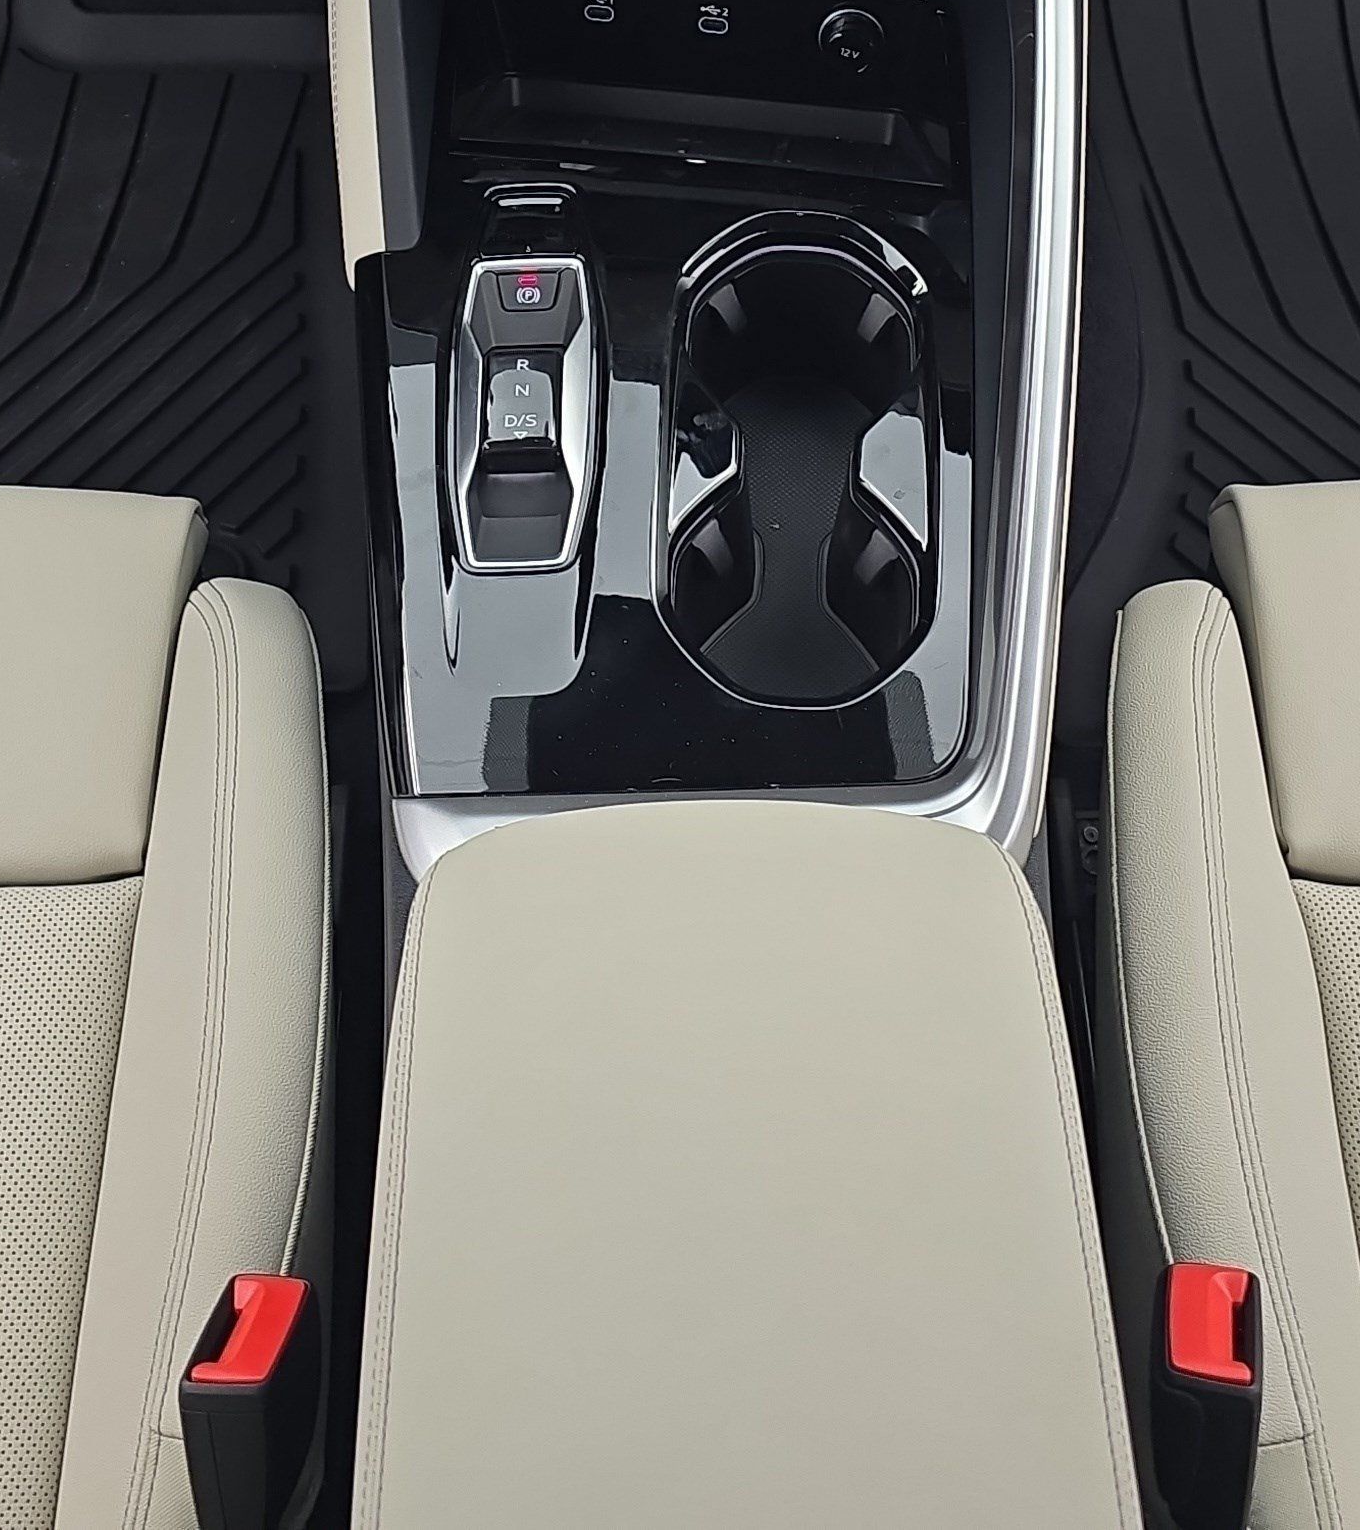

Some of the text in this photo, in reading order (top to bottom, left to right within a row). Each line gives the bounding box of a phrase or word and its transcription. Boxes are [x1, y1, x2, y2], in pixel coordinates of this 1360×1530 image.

[517, 358, 529, 371] R
[515, 384, 530, 396] N
[504, 414, 538, 428] D/S
